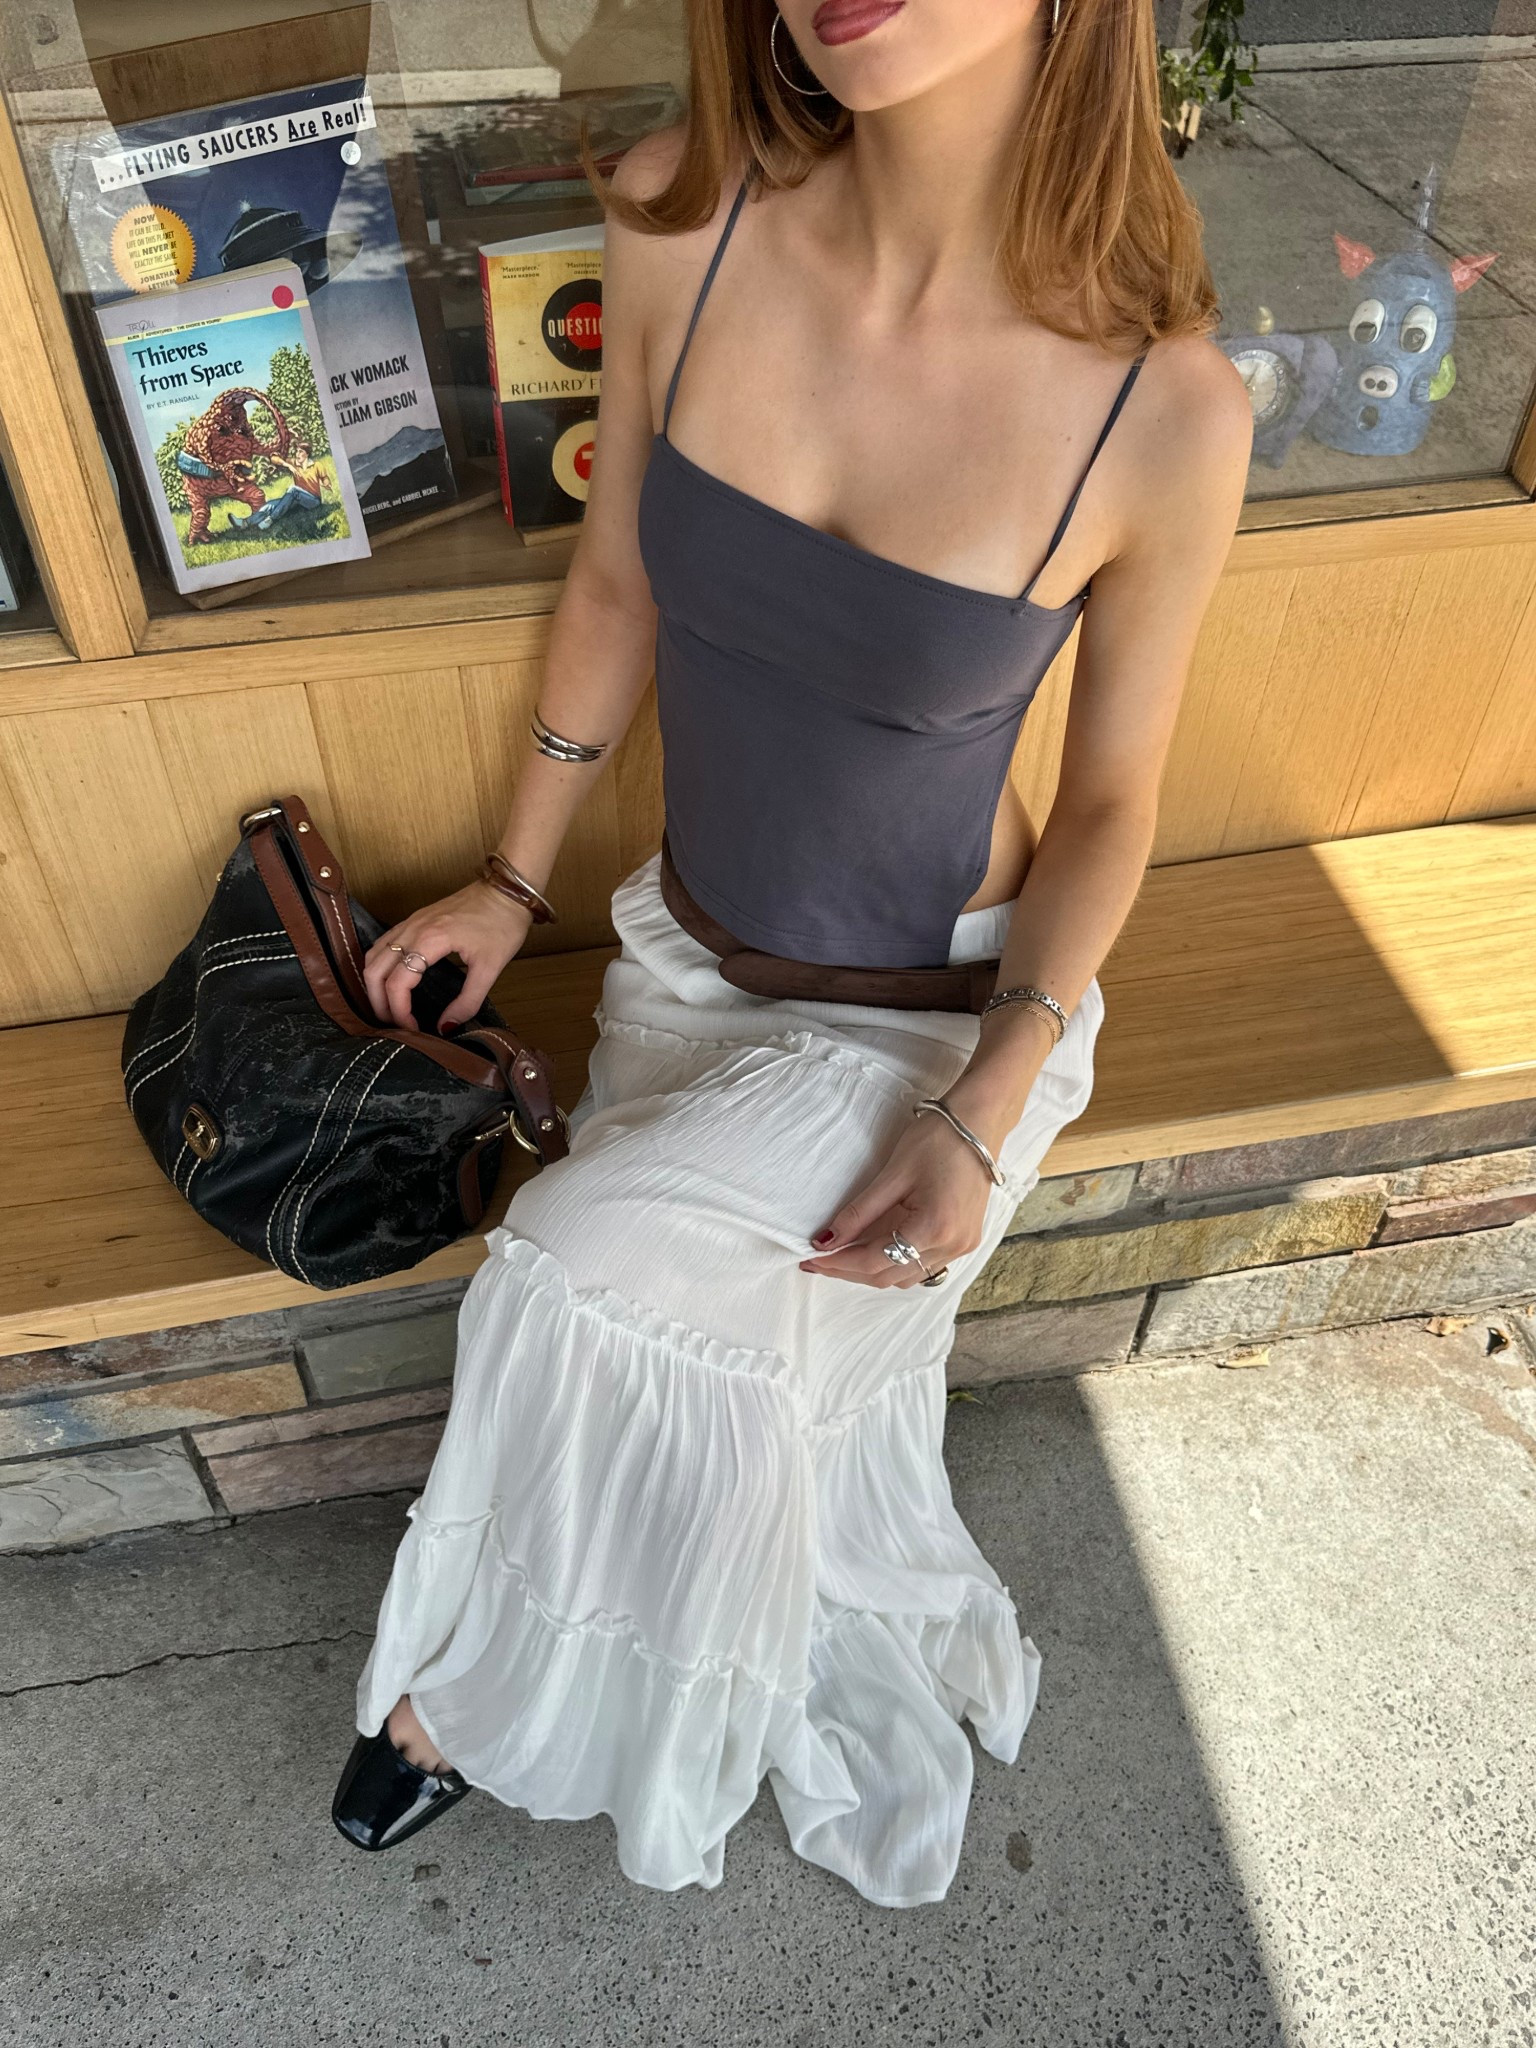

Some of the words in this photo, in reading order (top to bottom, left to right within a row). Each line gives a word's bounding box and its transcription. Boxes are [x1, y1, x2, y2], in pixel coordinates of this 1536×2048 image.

[198, 123, 279, 159] SAUCERS
[288, 119, 319, 142] Are
[322, 103, 367, 131] Real!
[134, 214, 155, 226] NOW
[129, 229, 134, 237] IT
[134, 226, 145, 236] CAN
[145, 225, 152, 234] BE
[126, 240, 136, 249] LIFE
[137, 238, 145, 247] ON
[145, 235, 156, 245] THIS
[156, 231, 174, 242] PLANET
[129, 250, 141, 259] WILL
[142, 243, 169, 256] NEVER
[170, 241, 177, 249] BE
[134, 257, 153, 269] EXACTLY
[154, 255, 163, 265] THE
[140, 268, 180, 284] JONATHAN
[148, 278, 176, 291] LETHEM
[125, 320, 156, 333] TROLL
[145, 327, 173, 337] ADVENTURES
[547, 317, 603, 339] QUESTI
[132, 341, 208, 369] Thieves
[139, 372, 189, 396] from
[190, 360, 245, 387] Space
[330, 373, 349, 394] CK
[351, 354, 409, 387] WOMACK
[511, 379, 583, 396] RICHARD
[590, 378, 602, 390] F
[157, 400, 167, 408] E.T.
[169, 394, 200, 405] RANDALL
[340, 404, 372, 429] LIAM
[374, 389, 418, 417] GIBSON
[352, 397, 359, 406] BY
[392, 497, 402, 506] and
[401, 491, 422, 504] GABRIEL
